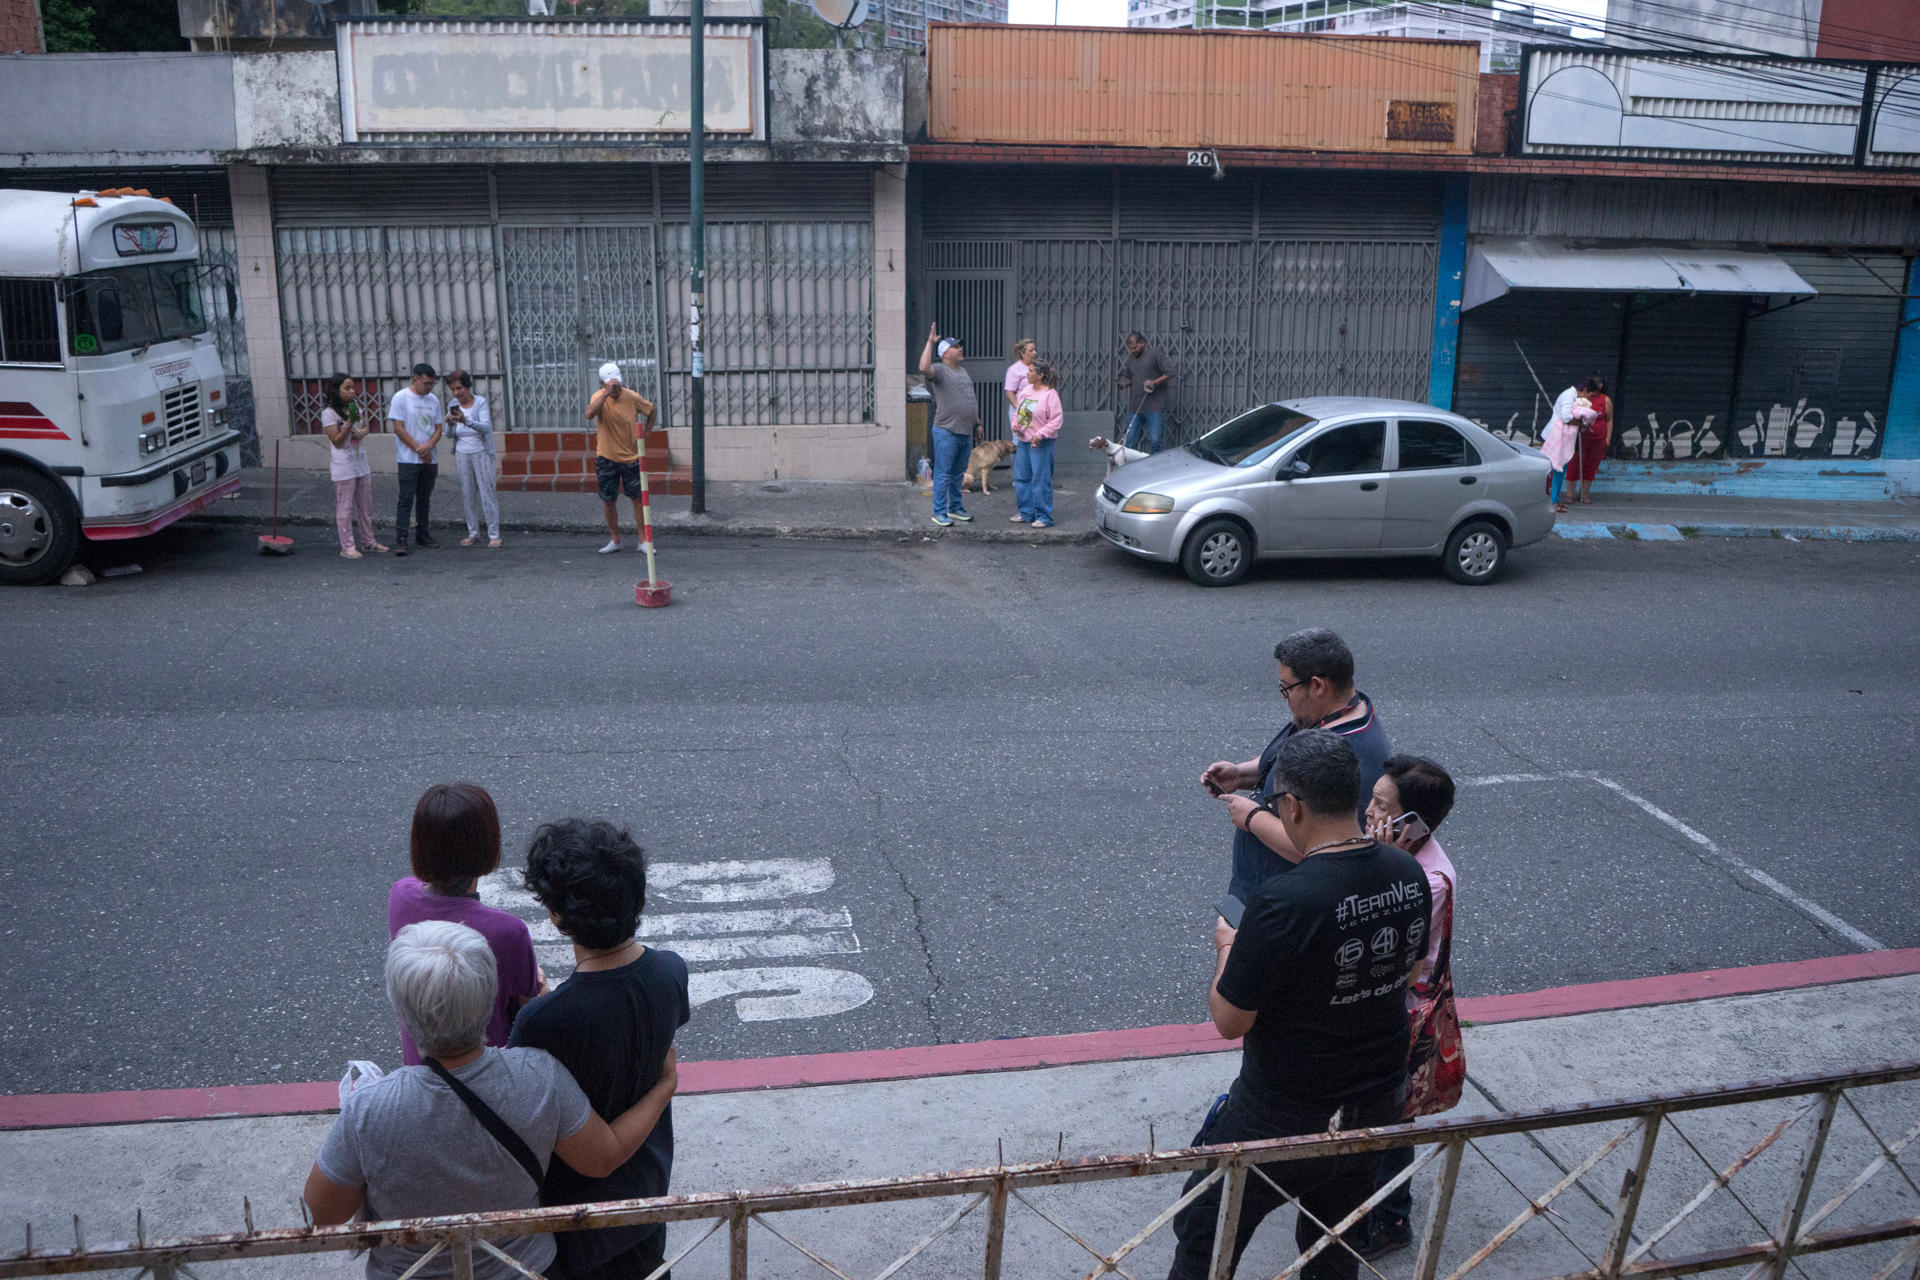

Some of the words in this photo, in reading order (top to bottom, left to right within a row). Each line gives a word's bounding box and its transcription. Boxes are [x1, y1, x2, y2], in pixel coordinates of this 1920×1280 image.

[1190, 152, 1212, 166] 20
[1337, 941, 1363, 966] 15
[1372, 927, 1394, 954] 41
